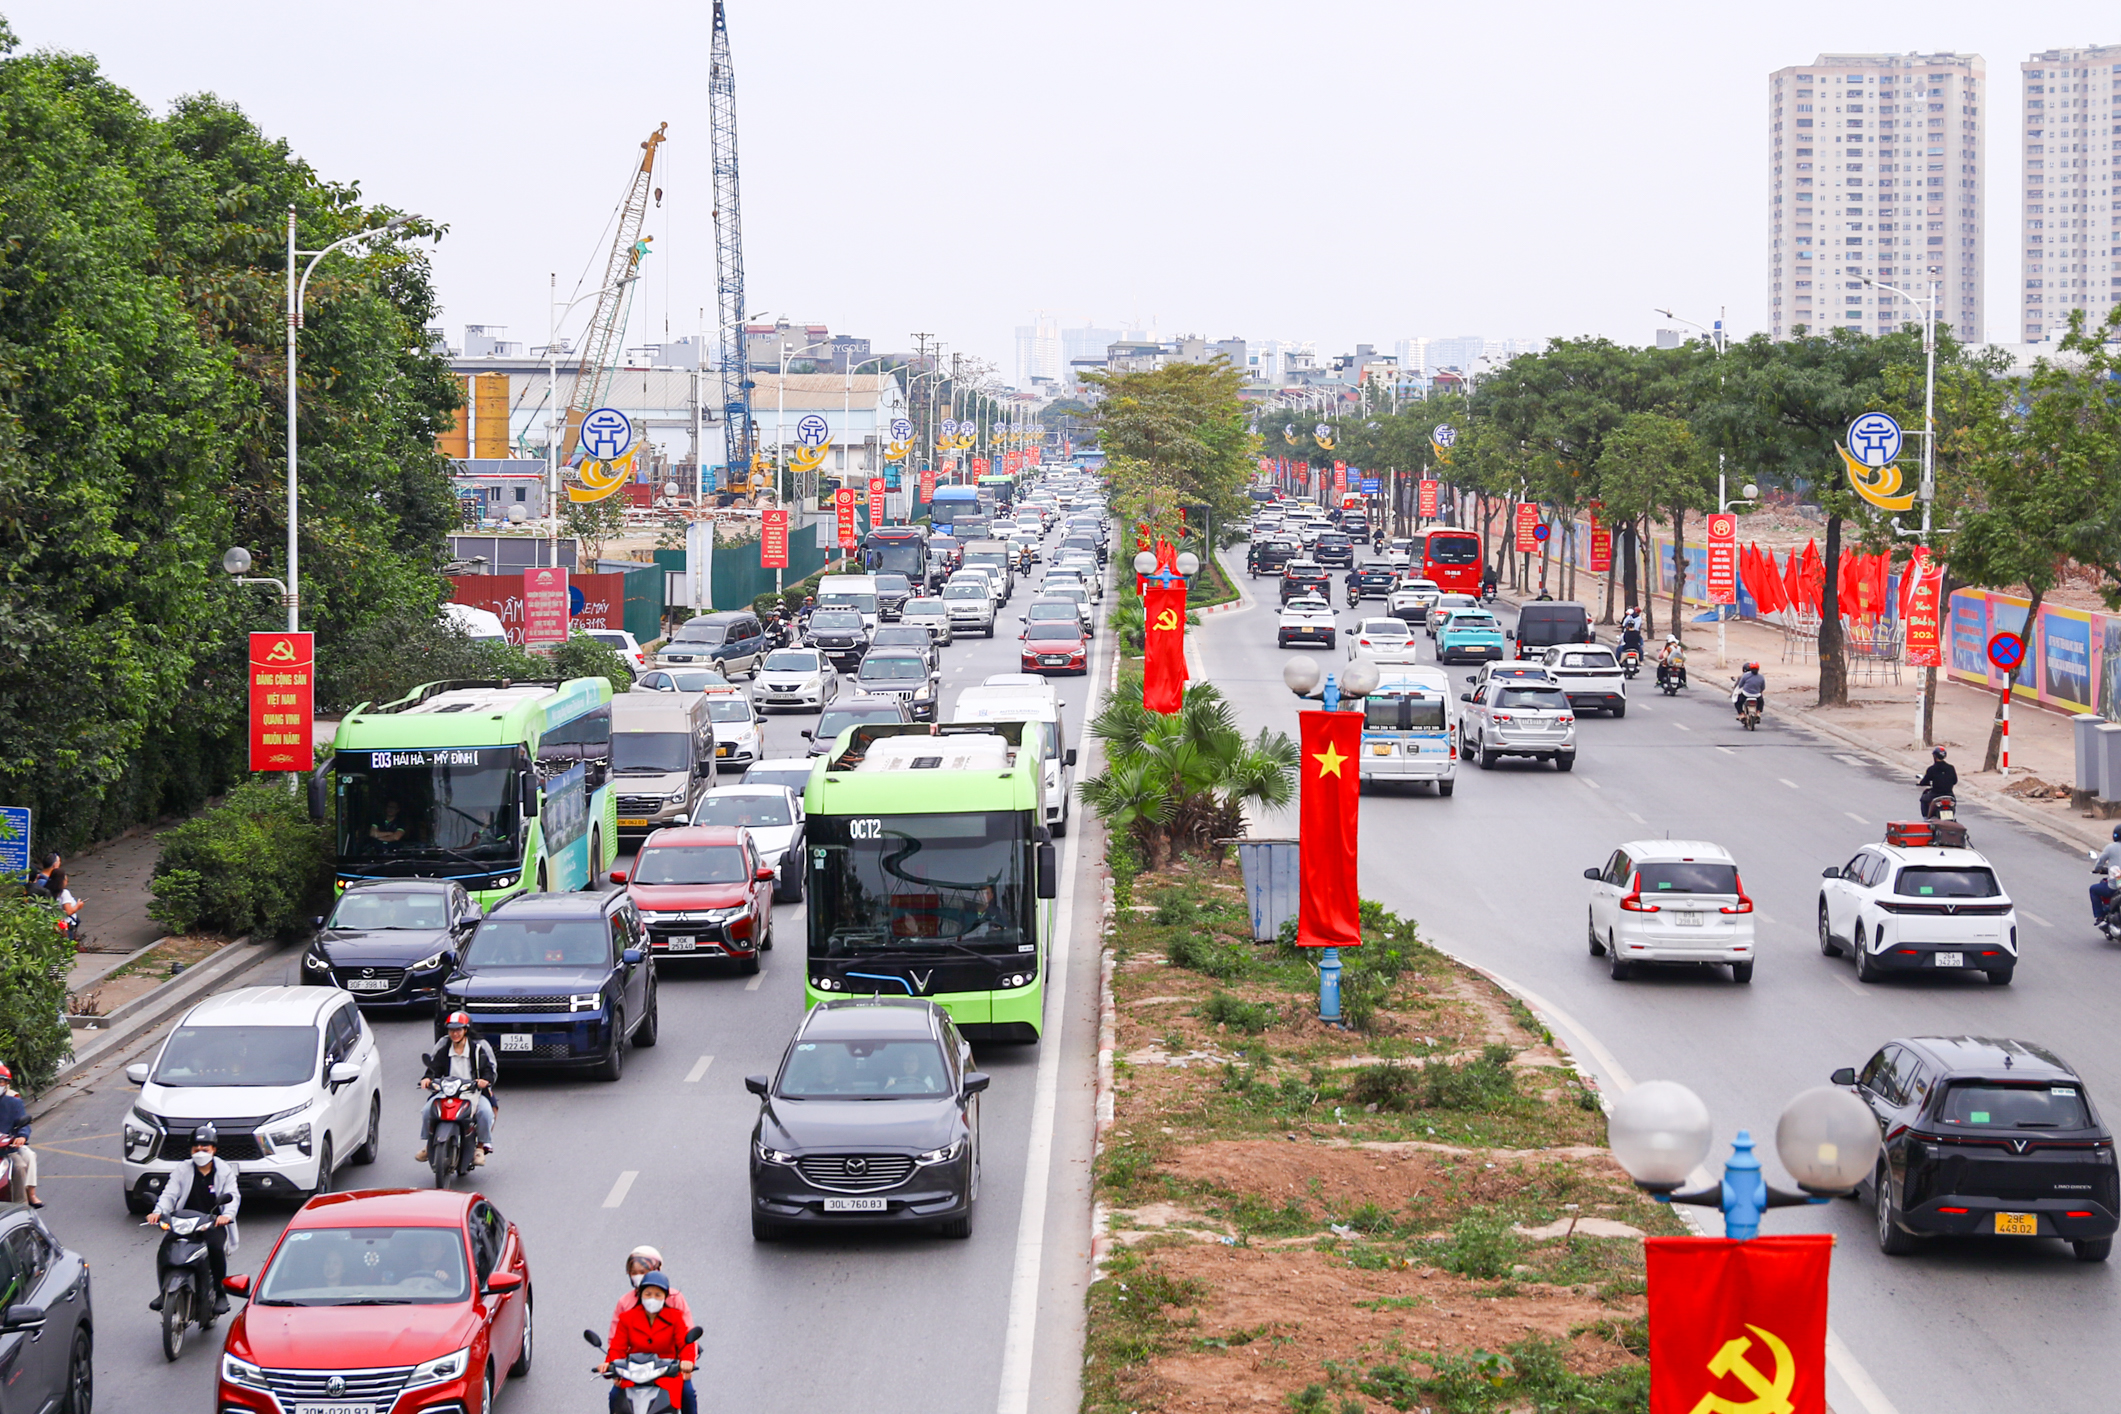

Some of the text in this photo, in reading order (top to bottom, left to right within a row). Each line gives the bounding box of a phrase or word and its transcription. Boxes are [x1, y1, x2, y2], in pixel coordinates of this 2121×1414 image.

[256, 671, 307, 687] ĐẢNG CỘNG SẢN
[267, 692, 296, 707] VIỆT NAM
[263, 714, 300, 726] QUANG VINH
[263, 732, 300, 744] MUÔN NĂM!
[372, 752, 392, 768] E03
[410, 751, 425, 765] HÀ
[434, 751, 448, 764] MỸ
[451, 750, 472, 764] ĐÌNH
[2007, 1215, 2024, 1223] 29E
[2000, 1225, 2032, 1233] 449.02
